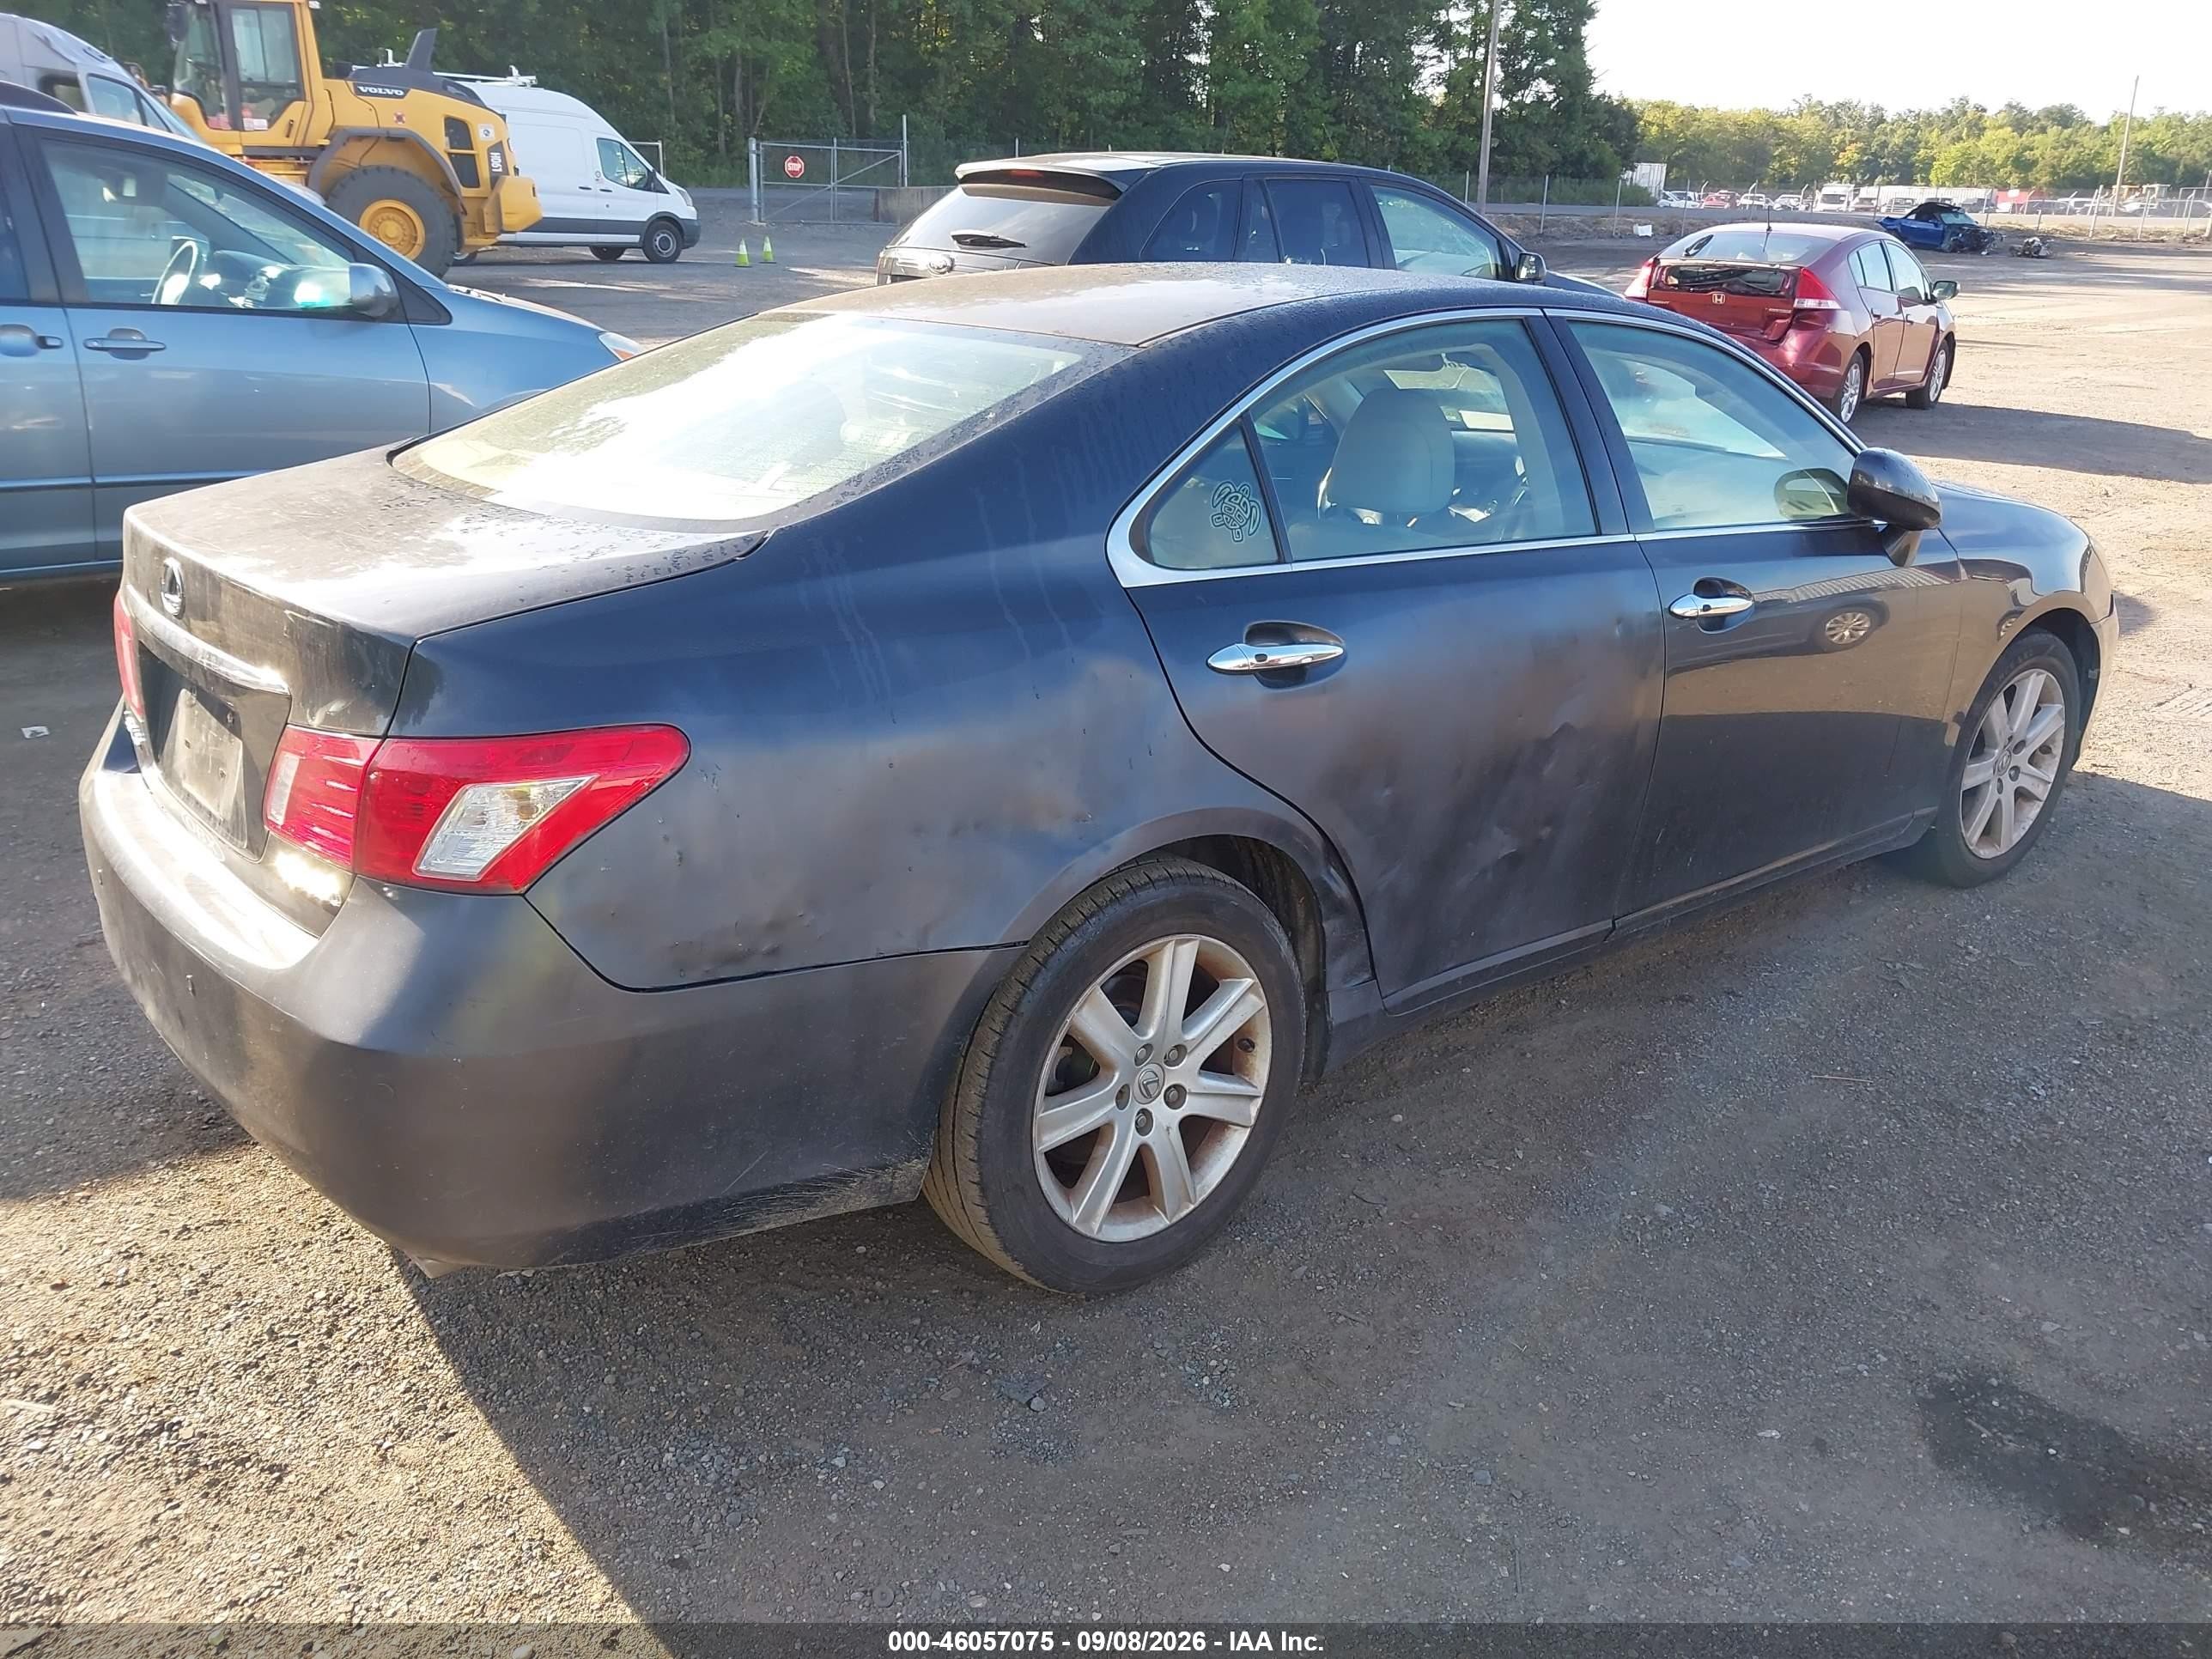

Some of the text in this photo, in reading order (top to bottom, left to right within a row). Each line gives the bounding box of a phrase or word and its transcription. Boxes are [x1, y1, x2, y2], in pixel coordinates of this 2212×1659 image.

[357, 86, 404, 96] VOLVO
[489, 152, 503, 173] L90H
[787, 162, 802, 171] STOP
